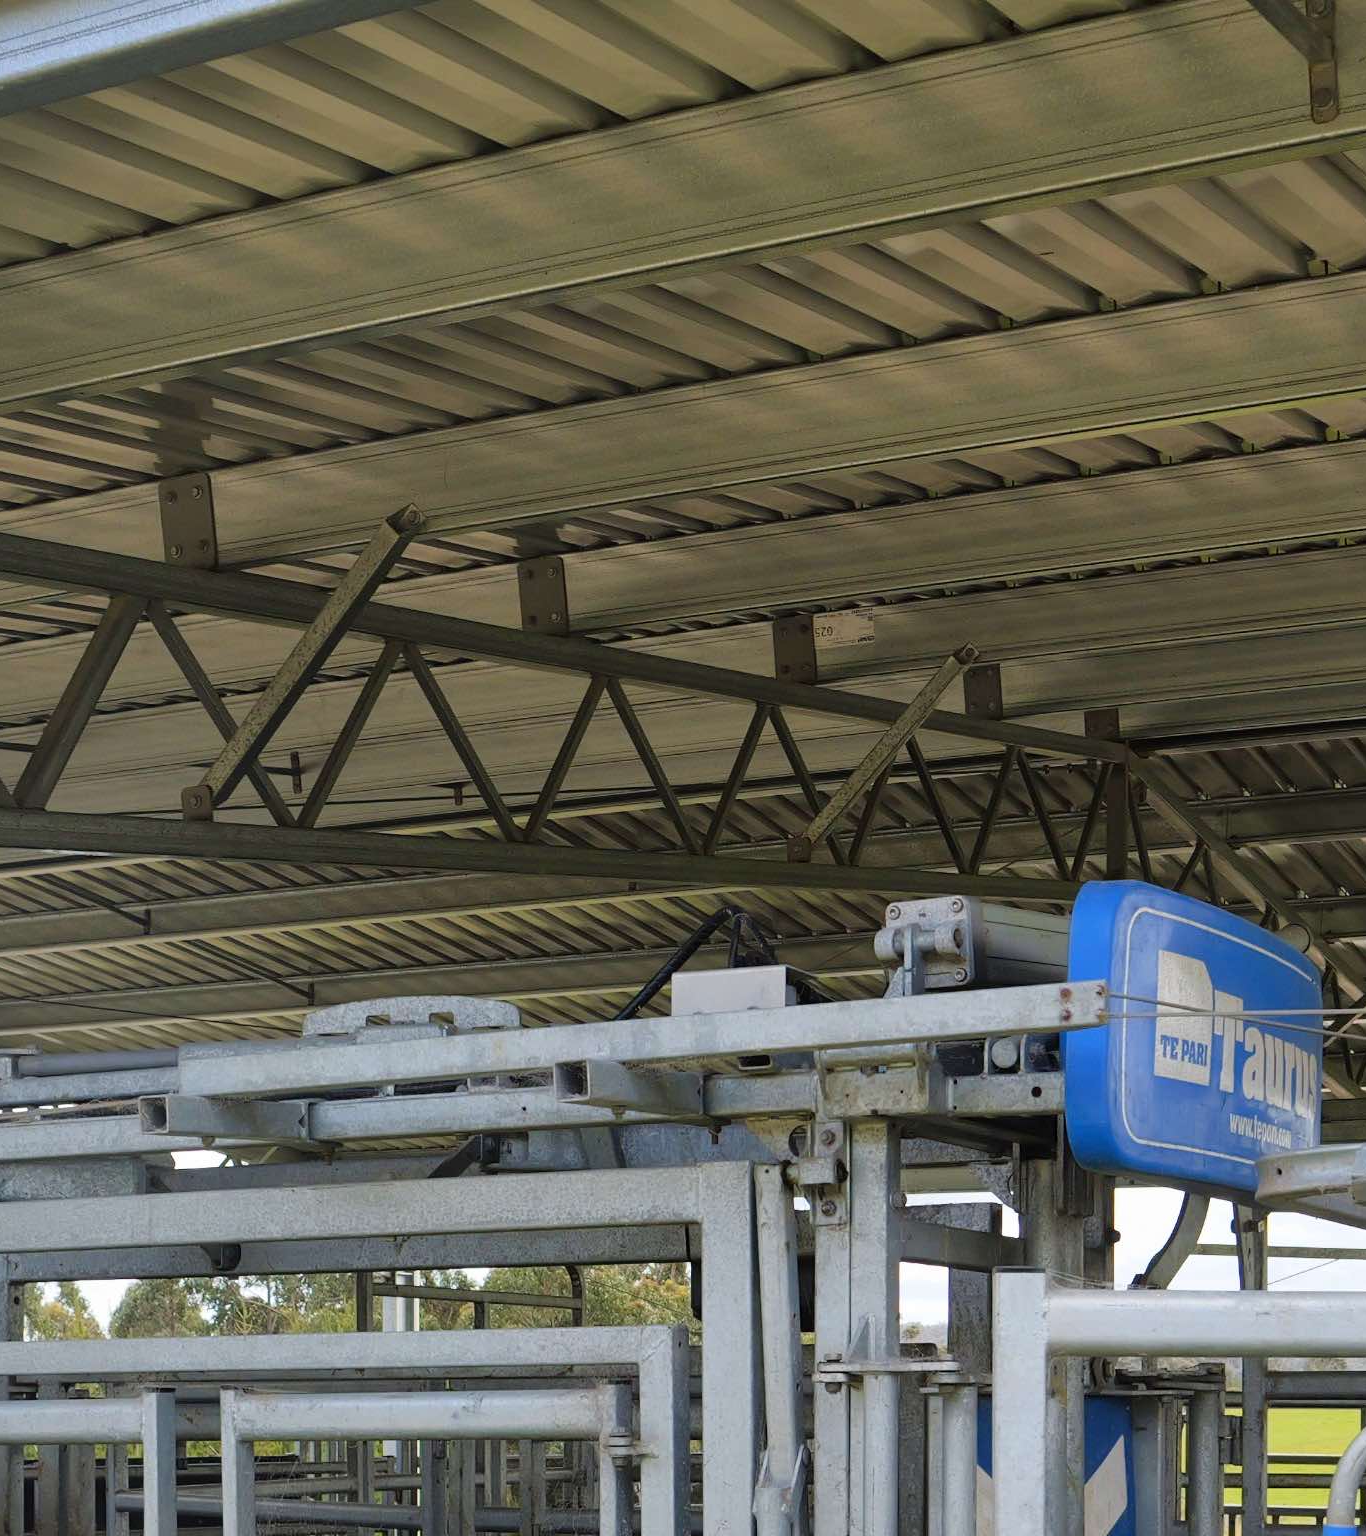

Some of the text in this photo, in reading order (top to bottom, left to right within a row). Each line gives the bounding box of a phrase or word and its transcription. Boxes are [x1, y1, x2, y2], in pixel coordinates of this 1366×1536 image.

[1160, 1034, 1208, 1067] TE PARI
[1213, 989, 1318, 1119] Taurus
